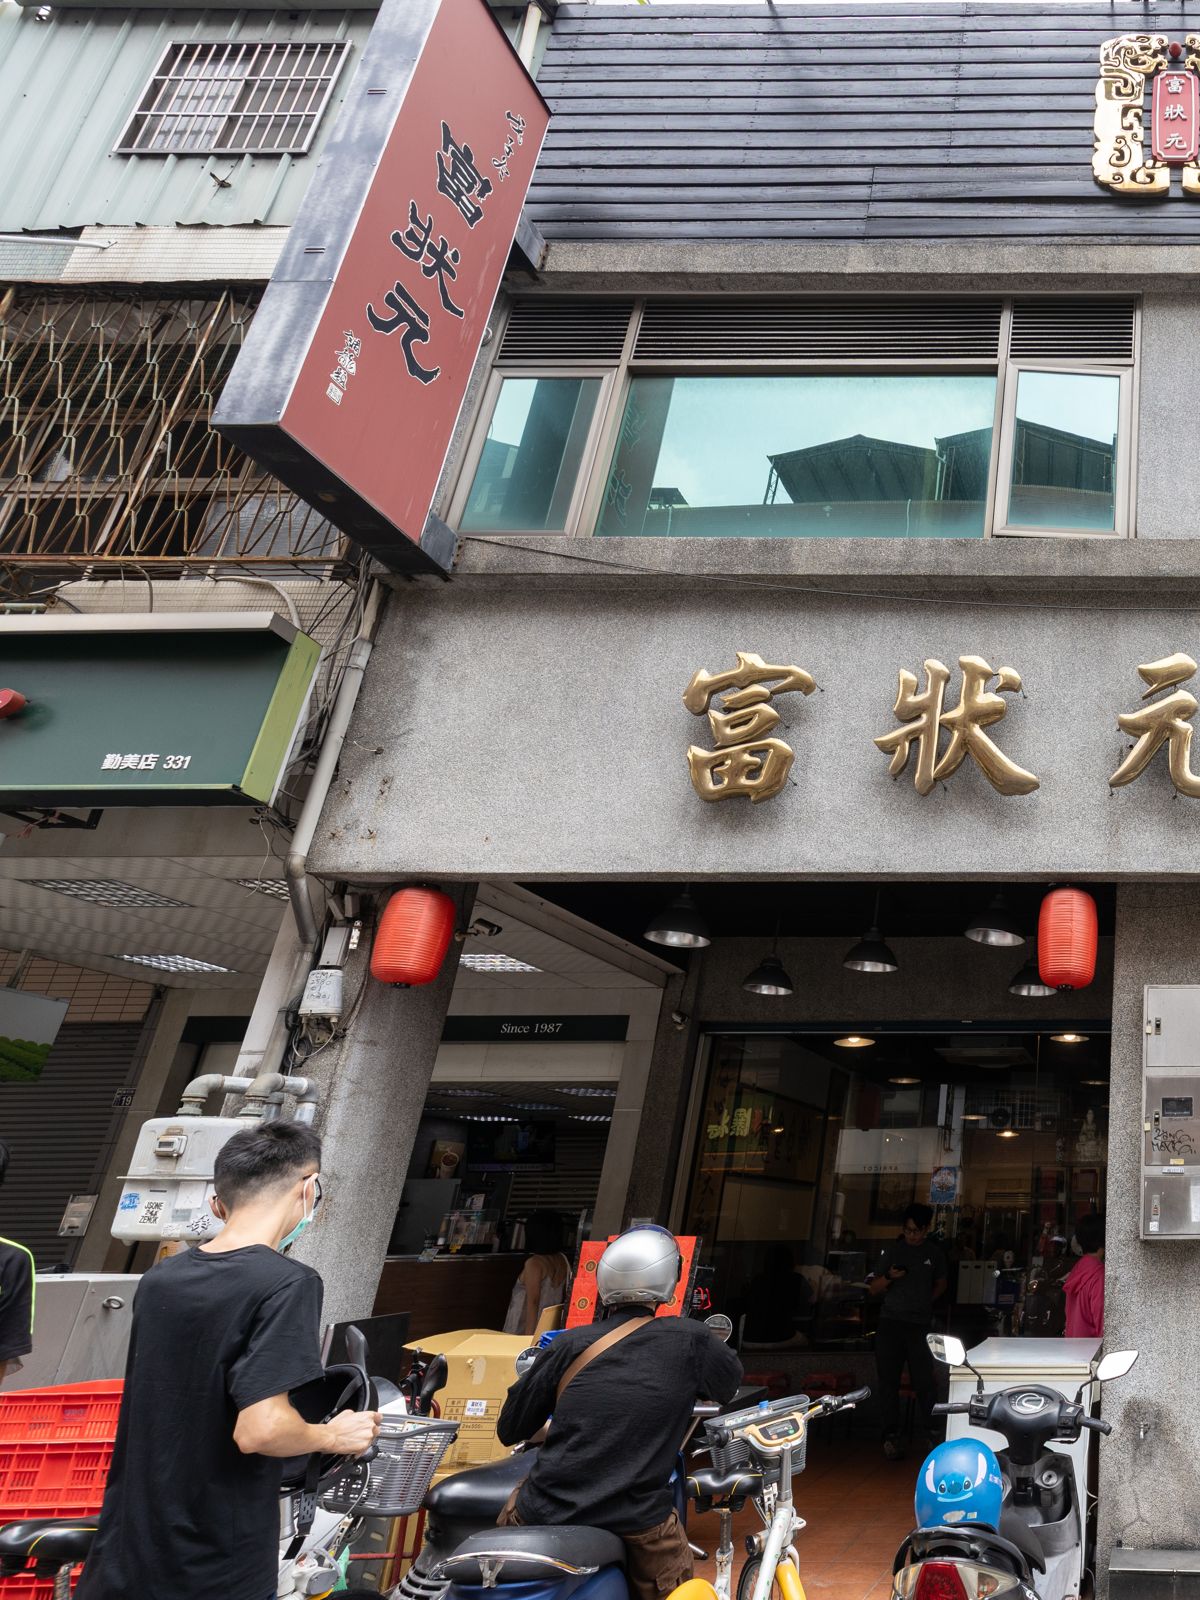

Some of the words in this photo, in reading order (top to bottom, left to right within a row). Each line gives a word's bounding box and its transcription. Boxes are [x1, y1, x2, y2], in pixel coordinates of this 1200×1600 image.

[1163, 76, 1188, 151] 富狀元
[101, 753, 160, 770] 勤美店
[162, 755, 192, 769] 331
[500, 1023, 530, 1034] Since
[534, 1023, 563, 1033] 1987
